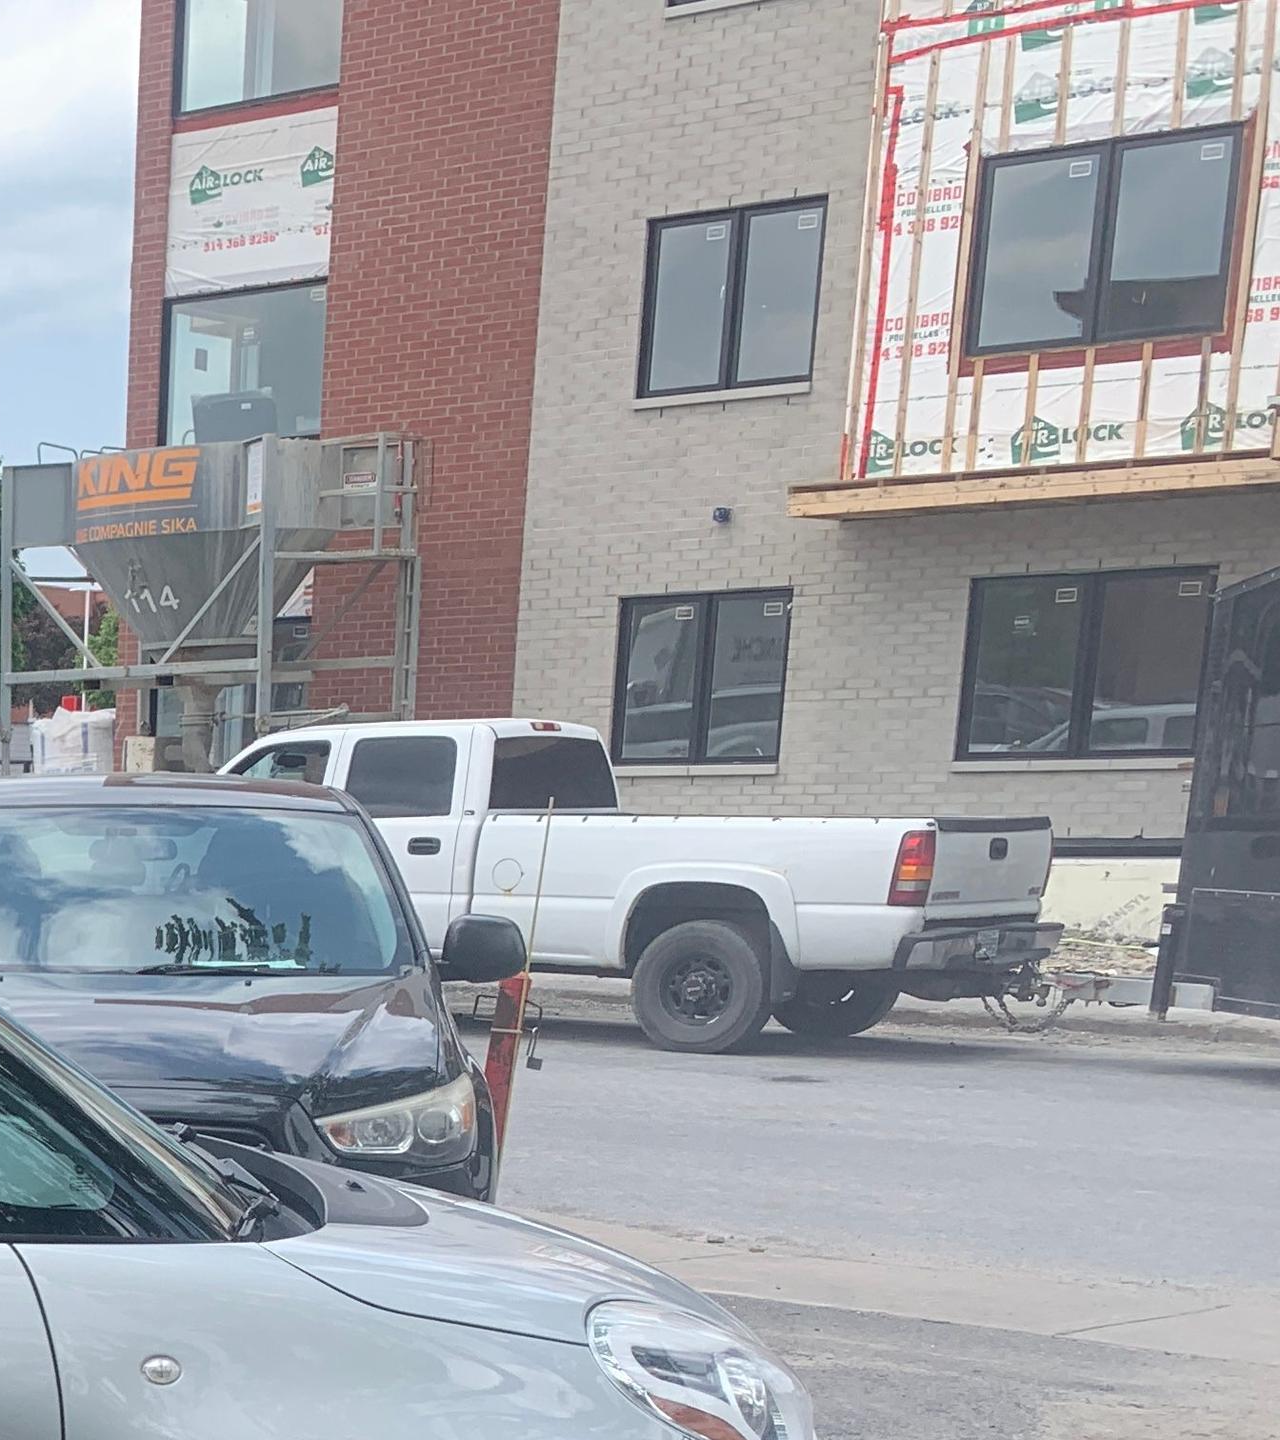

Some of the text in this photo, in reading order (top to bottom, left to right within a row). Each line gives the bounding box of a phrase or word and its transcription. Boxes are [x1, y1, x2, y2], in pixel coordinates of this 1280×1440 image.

[77, 447, 200, 498] KING
[88, 520, 157, 542] COMPAGNIE
[160, 516, 197, 534] SIKA
